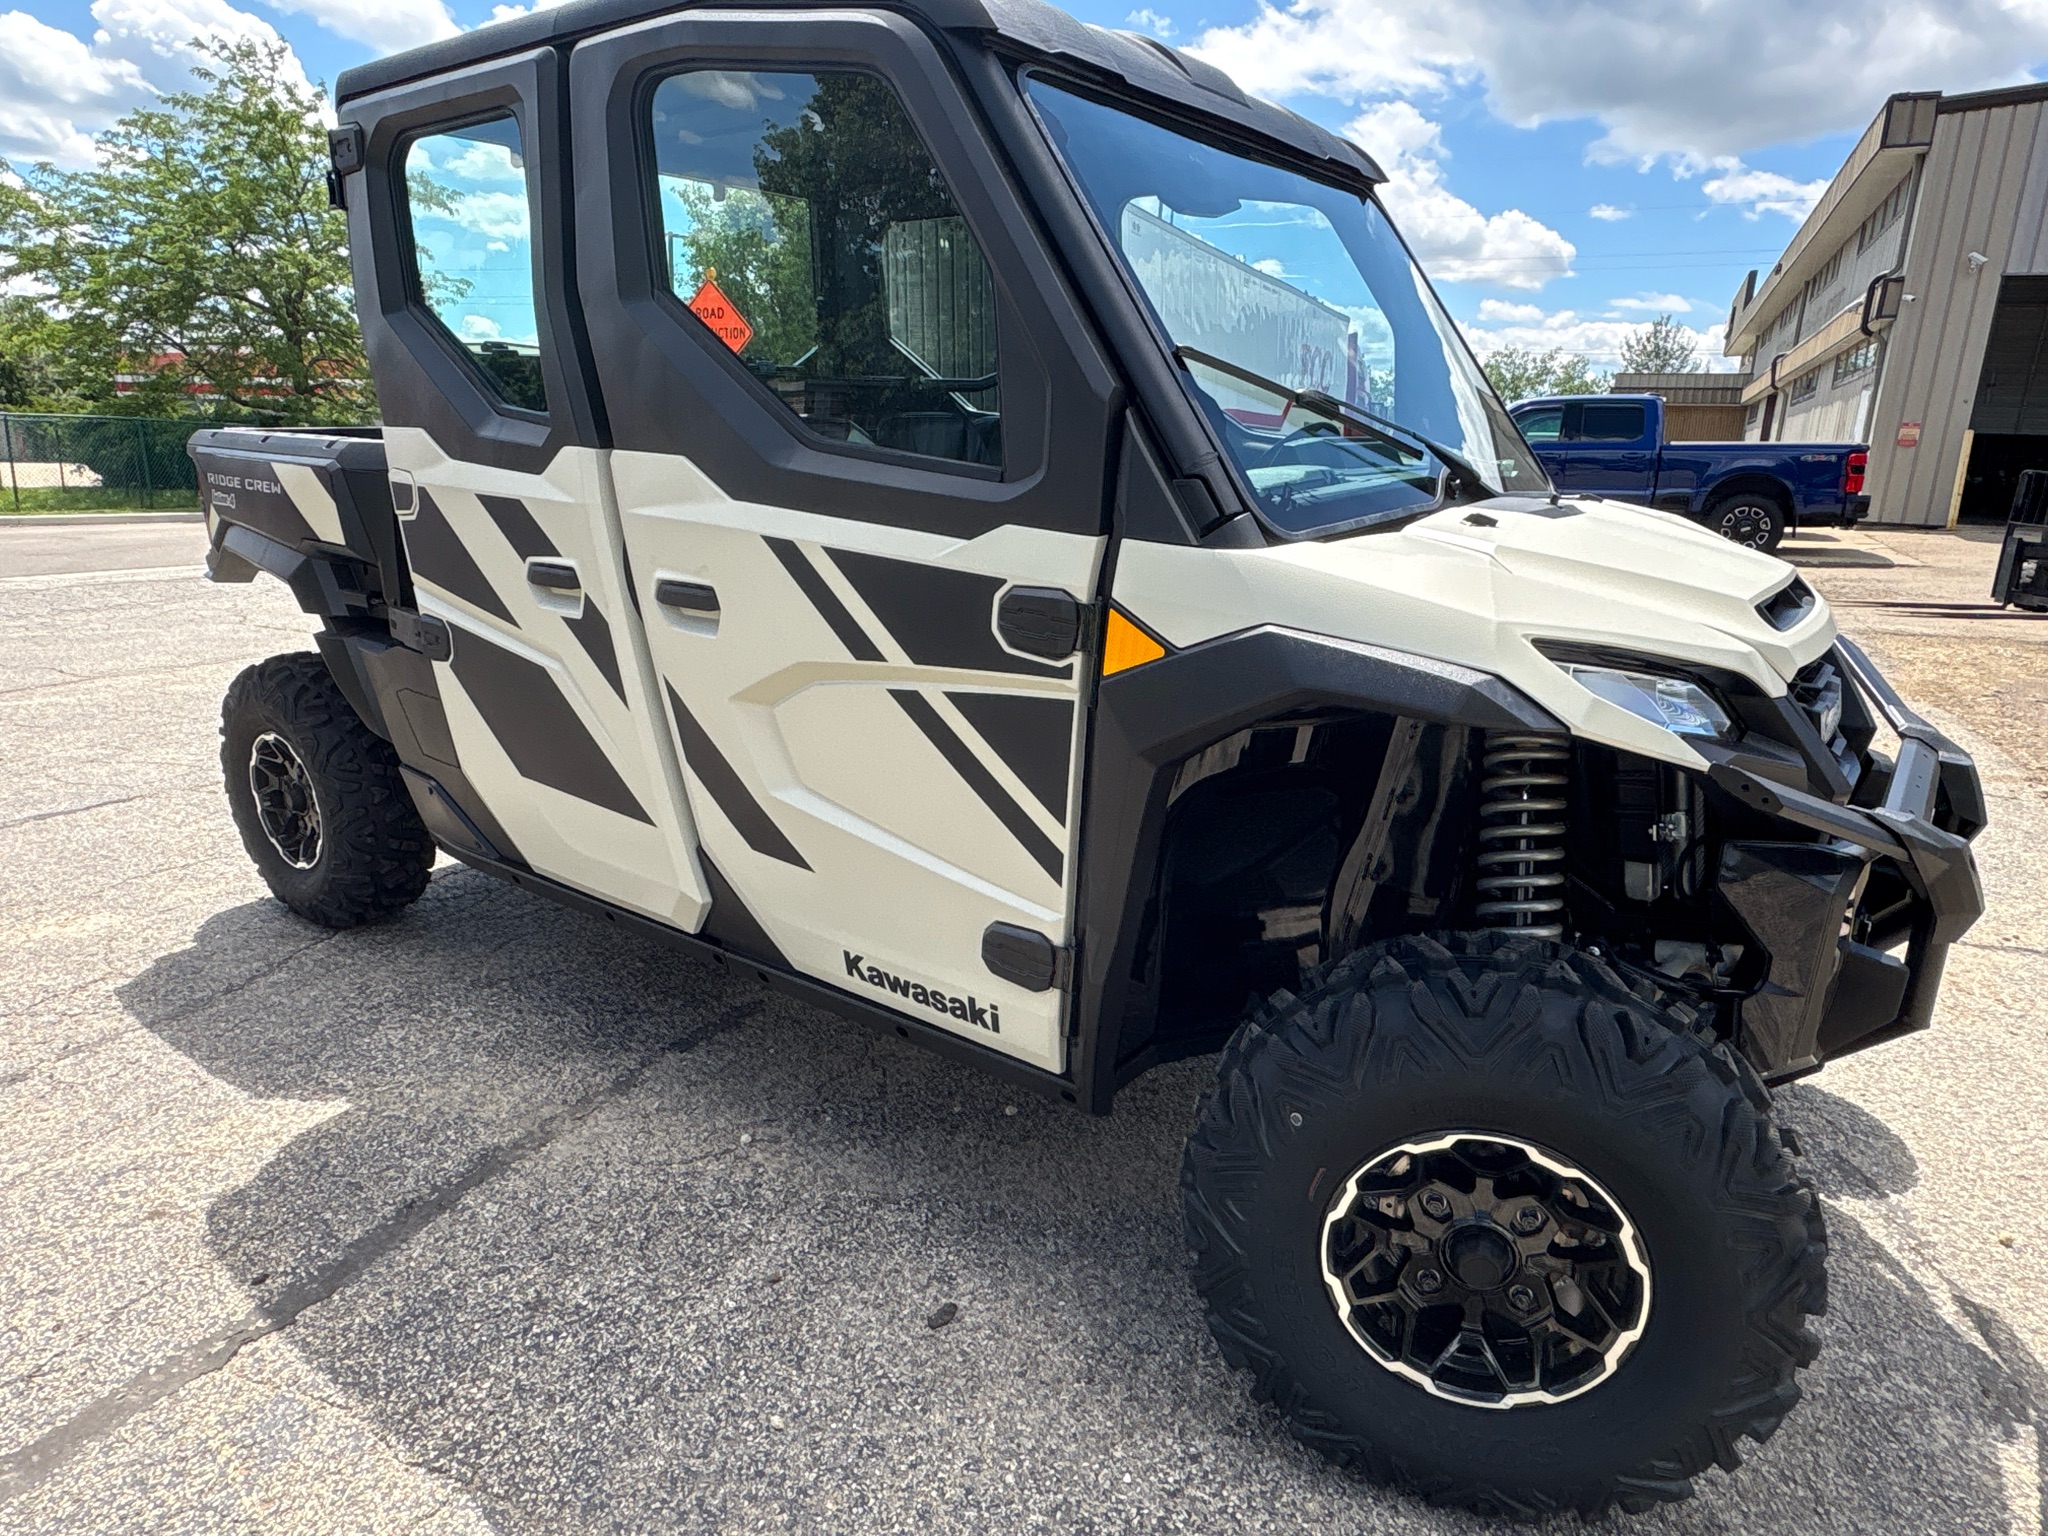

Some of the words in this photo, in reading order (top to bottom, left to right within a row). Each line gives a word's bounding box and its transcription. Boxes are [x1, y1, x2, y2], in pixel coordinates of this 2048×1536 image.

[206, 472, 241, 488] RIDGE
[244, 478, 281, 494] CREW
[843, 949, 1000, 1033] Kawasaki
